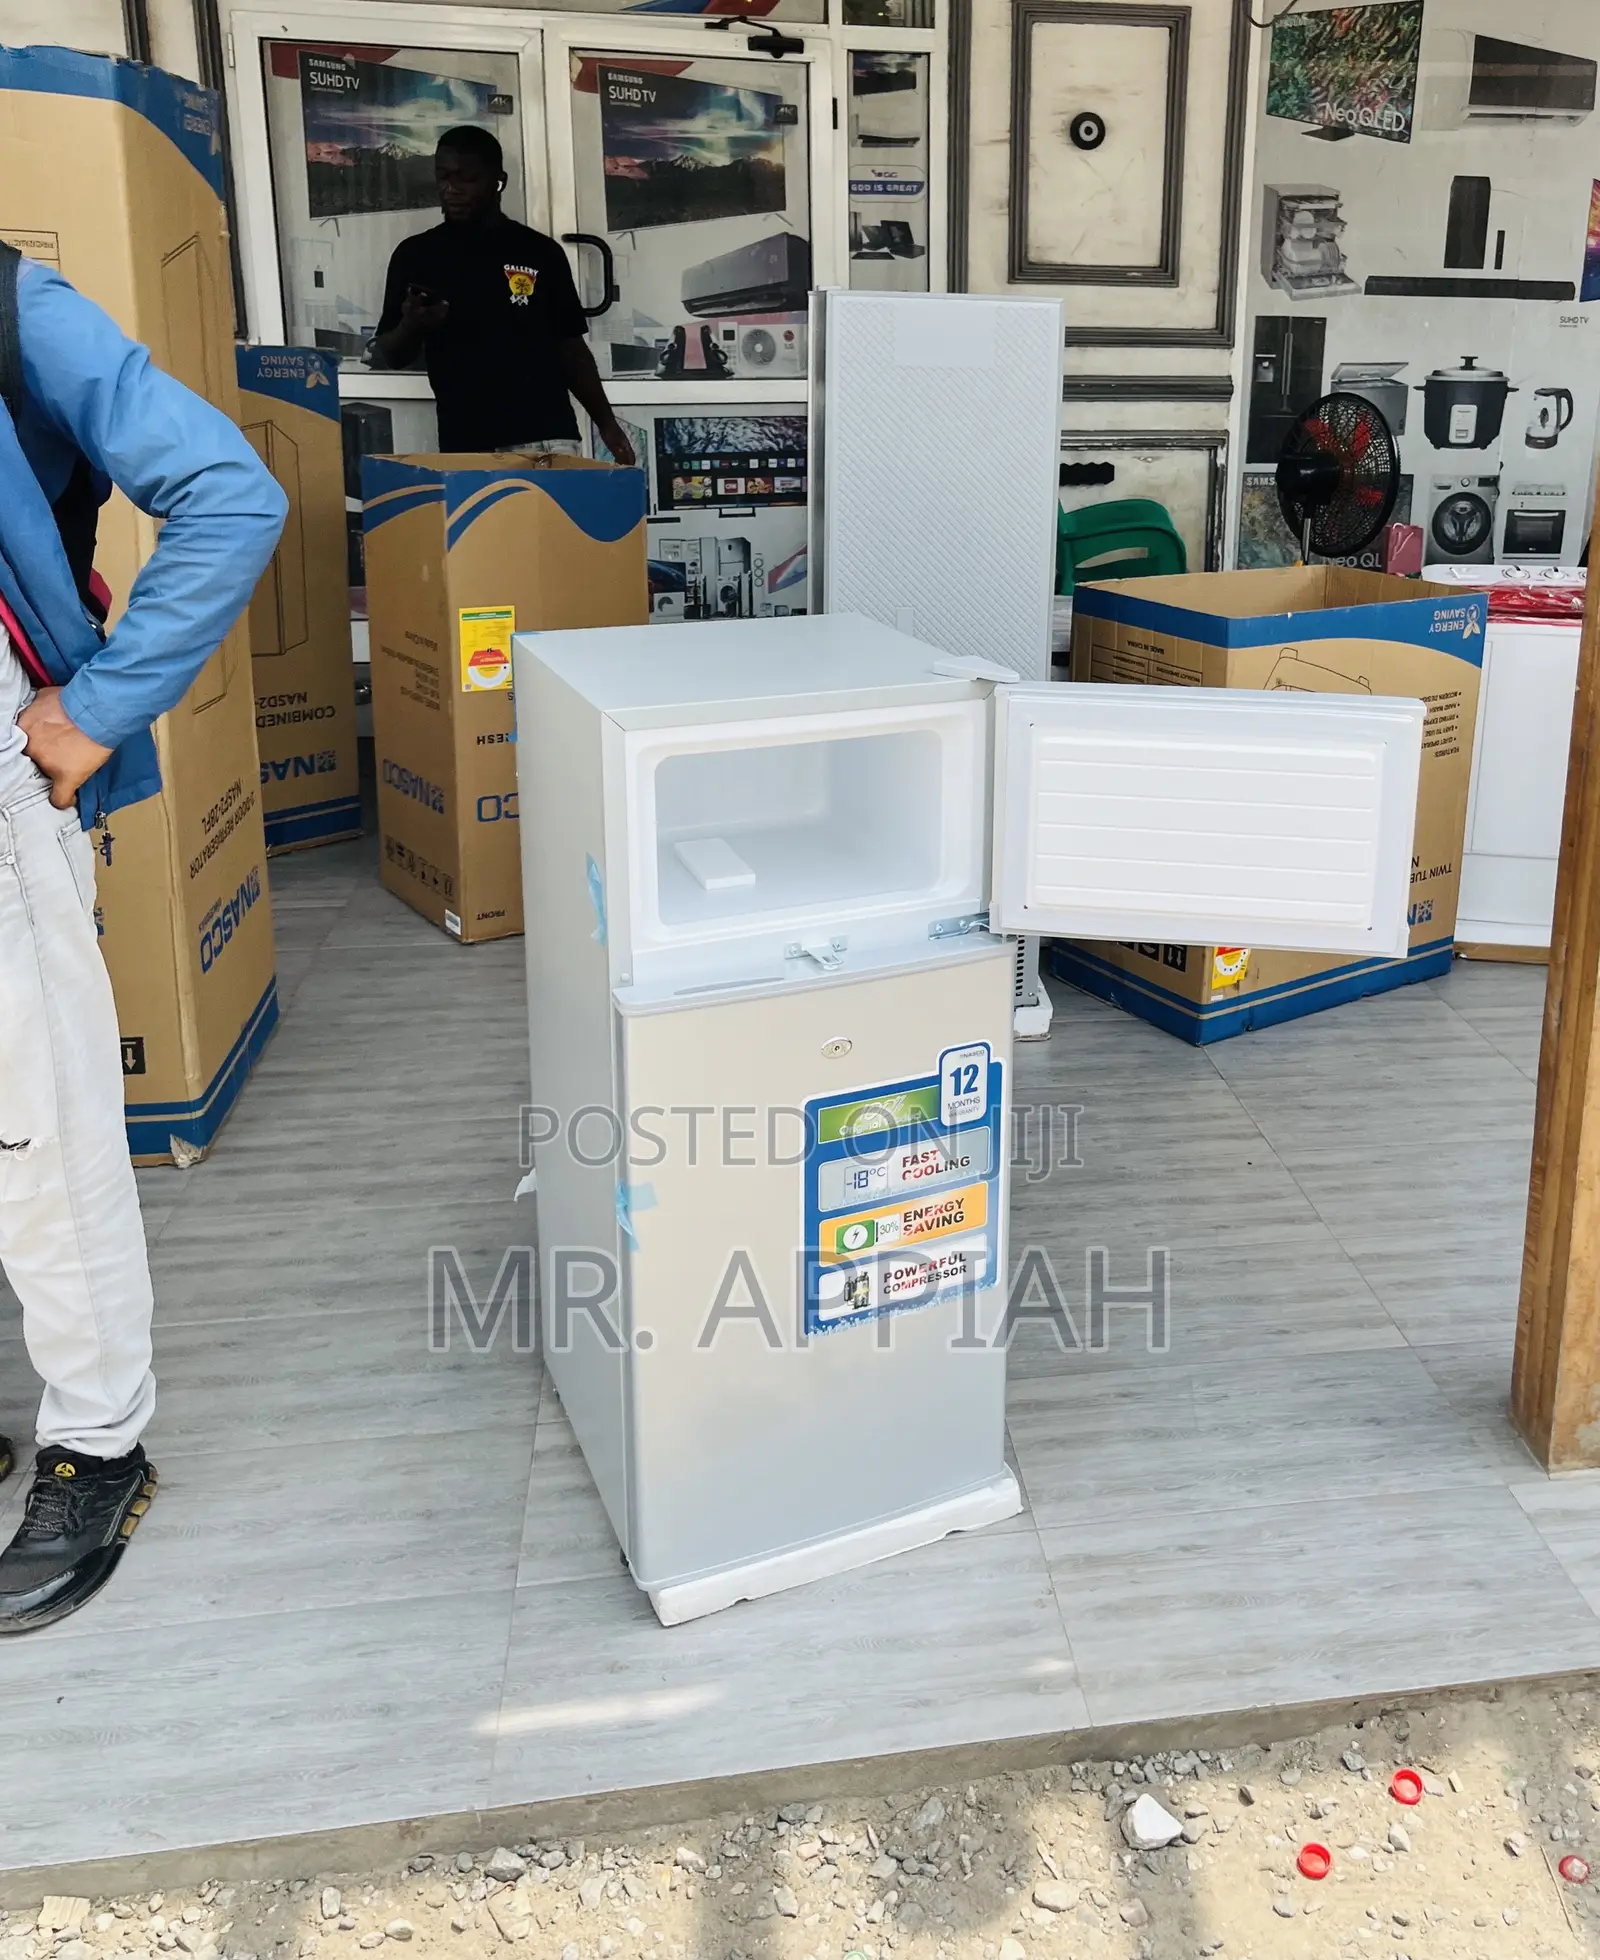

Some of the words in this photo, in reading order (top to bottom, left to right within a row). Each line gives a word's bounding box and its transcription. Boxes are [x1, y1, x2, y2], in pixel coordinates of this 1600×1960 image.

[1359, 107, 1406, 131] QLED
[851, 183, 871, 192] GOD
[874, 183, 884, 192] IS
[886, 184, 918, 192] GREAT
[260, 355, 305, 366] SAVING
[257, 367, 305, 379] ENERGY
[1433, 607, 1466, 621] SAVING
[1428, 620, 1465, 634] ENERGY
[255, 705, 336, 728] COMBINED
[1430, 862, 1453, 879] TWIN
[200, 874, 256, 975] NASCO
[476, 909, 506, 921] FRONT
[949, 1063, 979, 1097] 12
[947, 1096, 981, 1110] MONTHS
[901, 1156, 971, 1182] COOLING
[902, 1149, 941, 1169] FAST
[903, 1198, 965, 1224] ENERGY
[879, 1221, 899, 1235] 30%
[903, 1211, 965, 1236] SAVING
[884, 1252, 967, 1283] POWERFUL
[883, 1264, 967, 1295] COMPRESSOR
